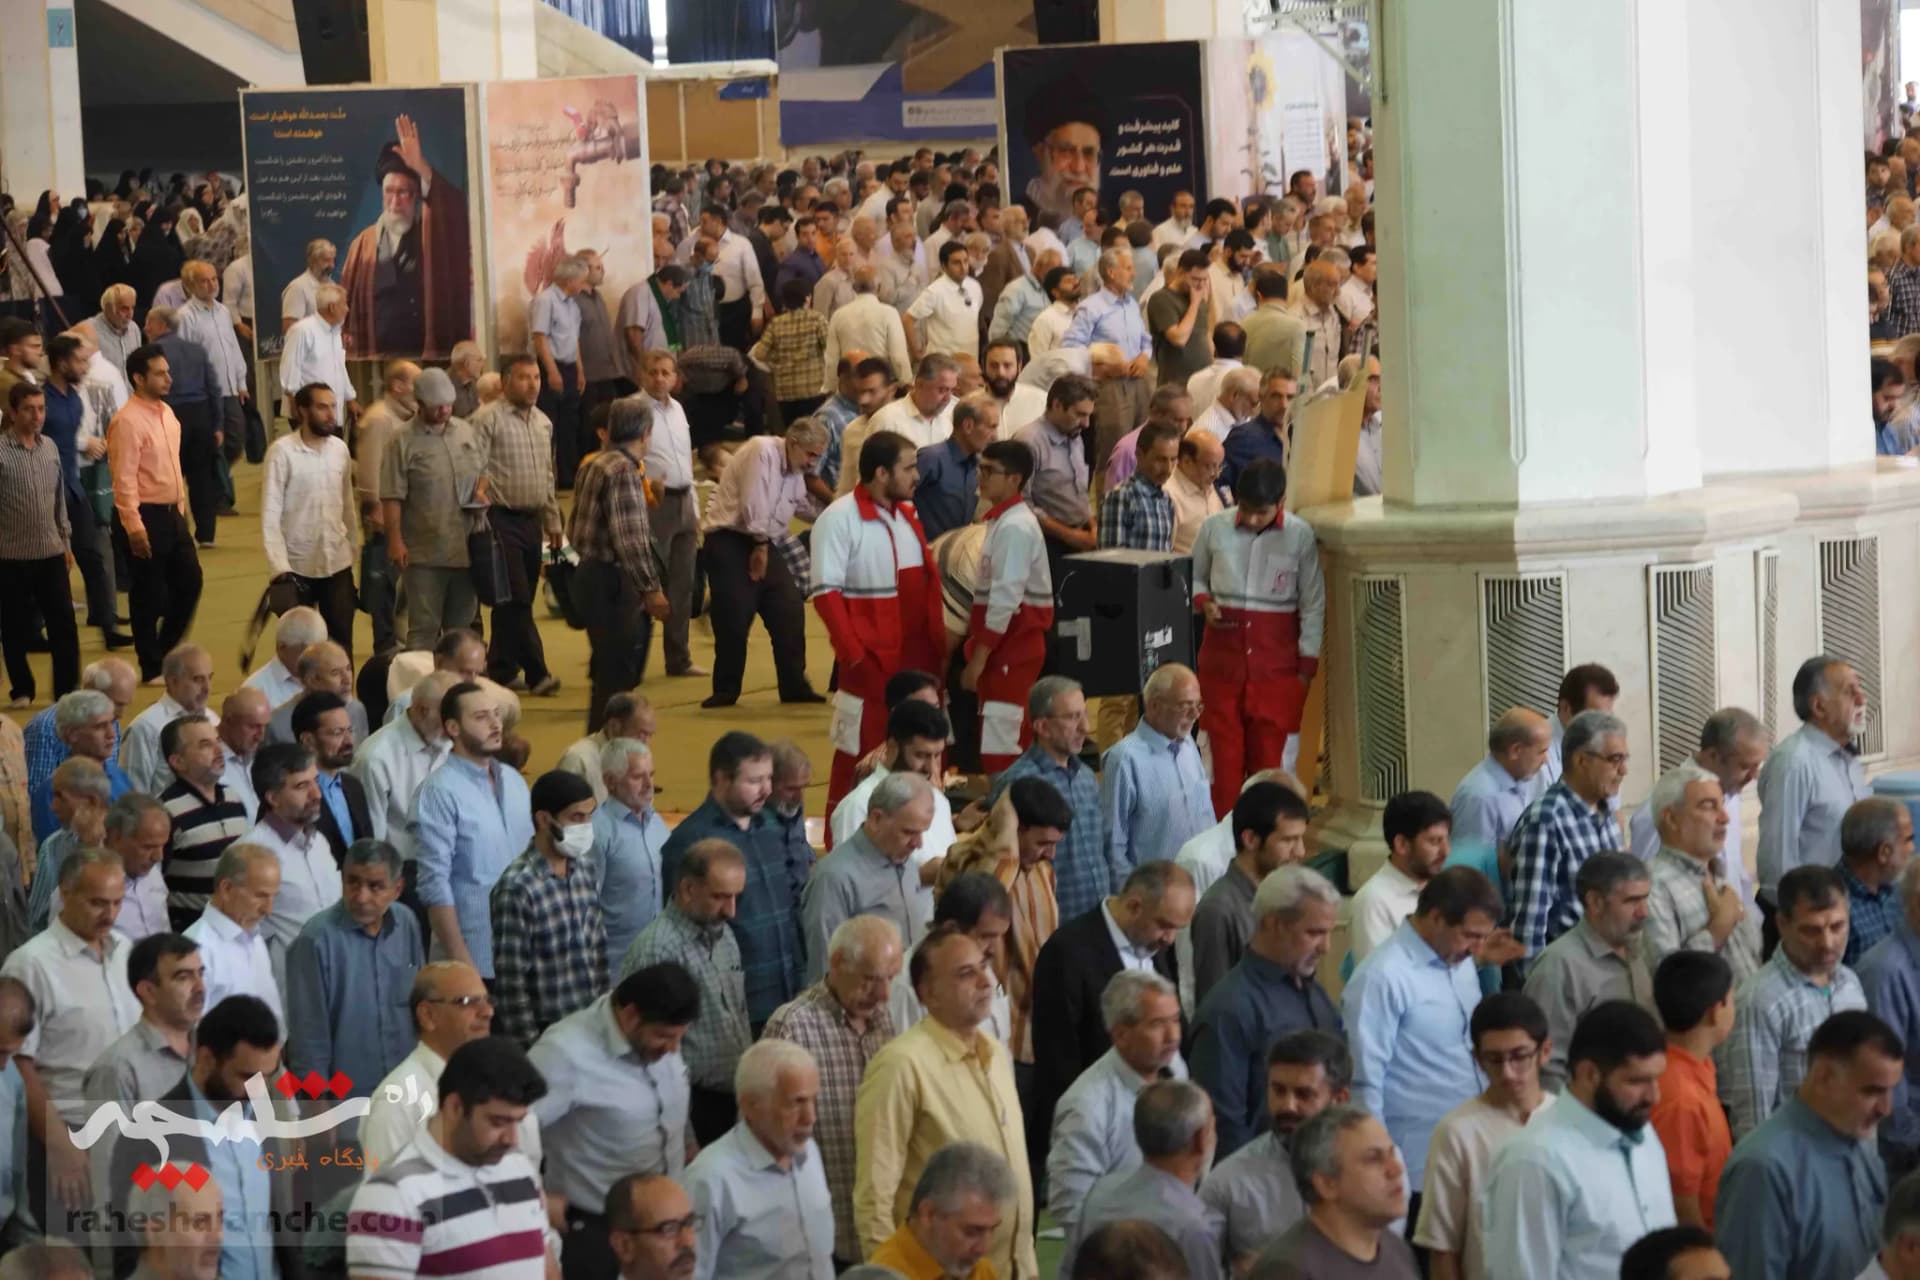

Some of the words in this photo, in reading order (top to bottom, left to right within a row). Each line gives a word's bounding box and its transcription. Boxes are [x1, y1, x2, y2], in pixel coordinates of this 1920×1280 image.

[1117, 124, 1124, 136] و
[1125, 116, 1161, 136] پیشرفت
[1162, 117, 1181, 134] کلید
[1115, 140, 1142, 157] کشور
[1142, 142, 1156, 157] هر
[1157, 138, 1182, 155] قدرت
[1131, 160, 1159, 178] فناوری
[1159, 165, 1165, 177] و
[1165, 161, 1183, 177] علم
